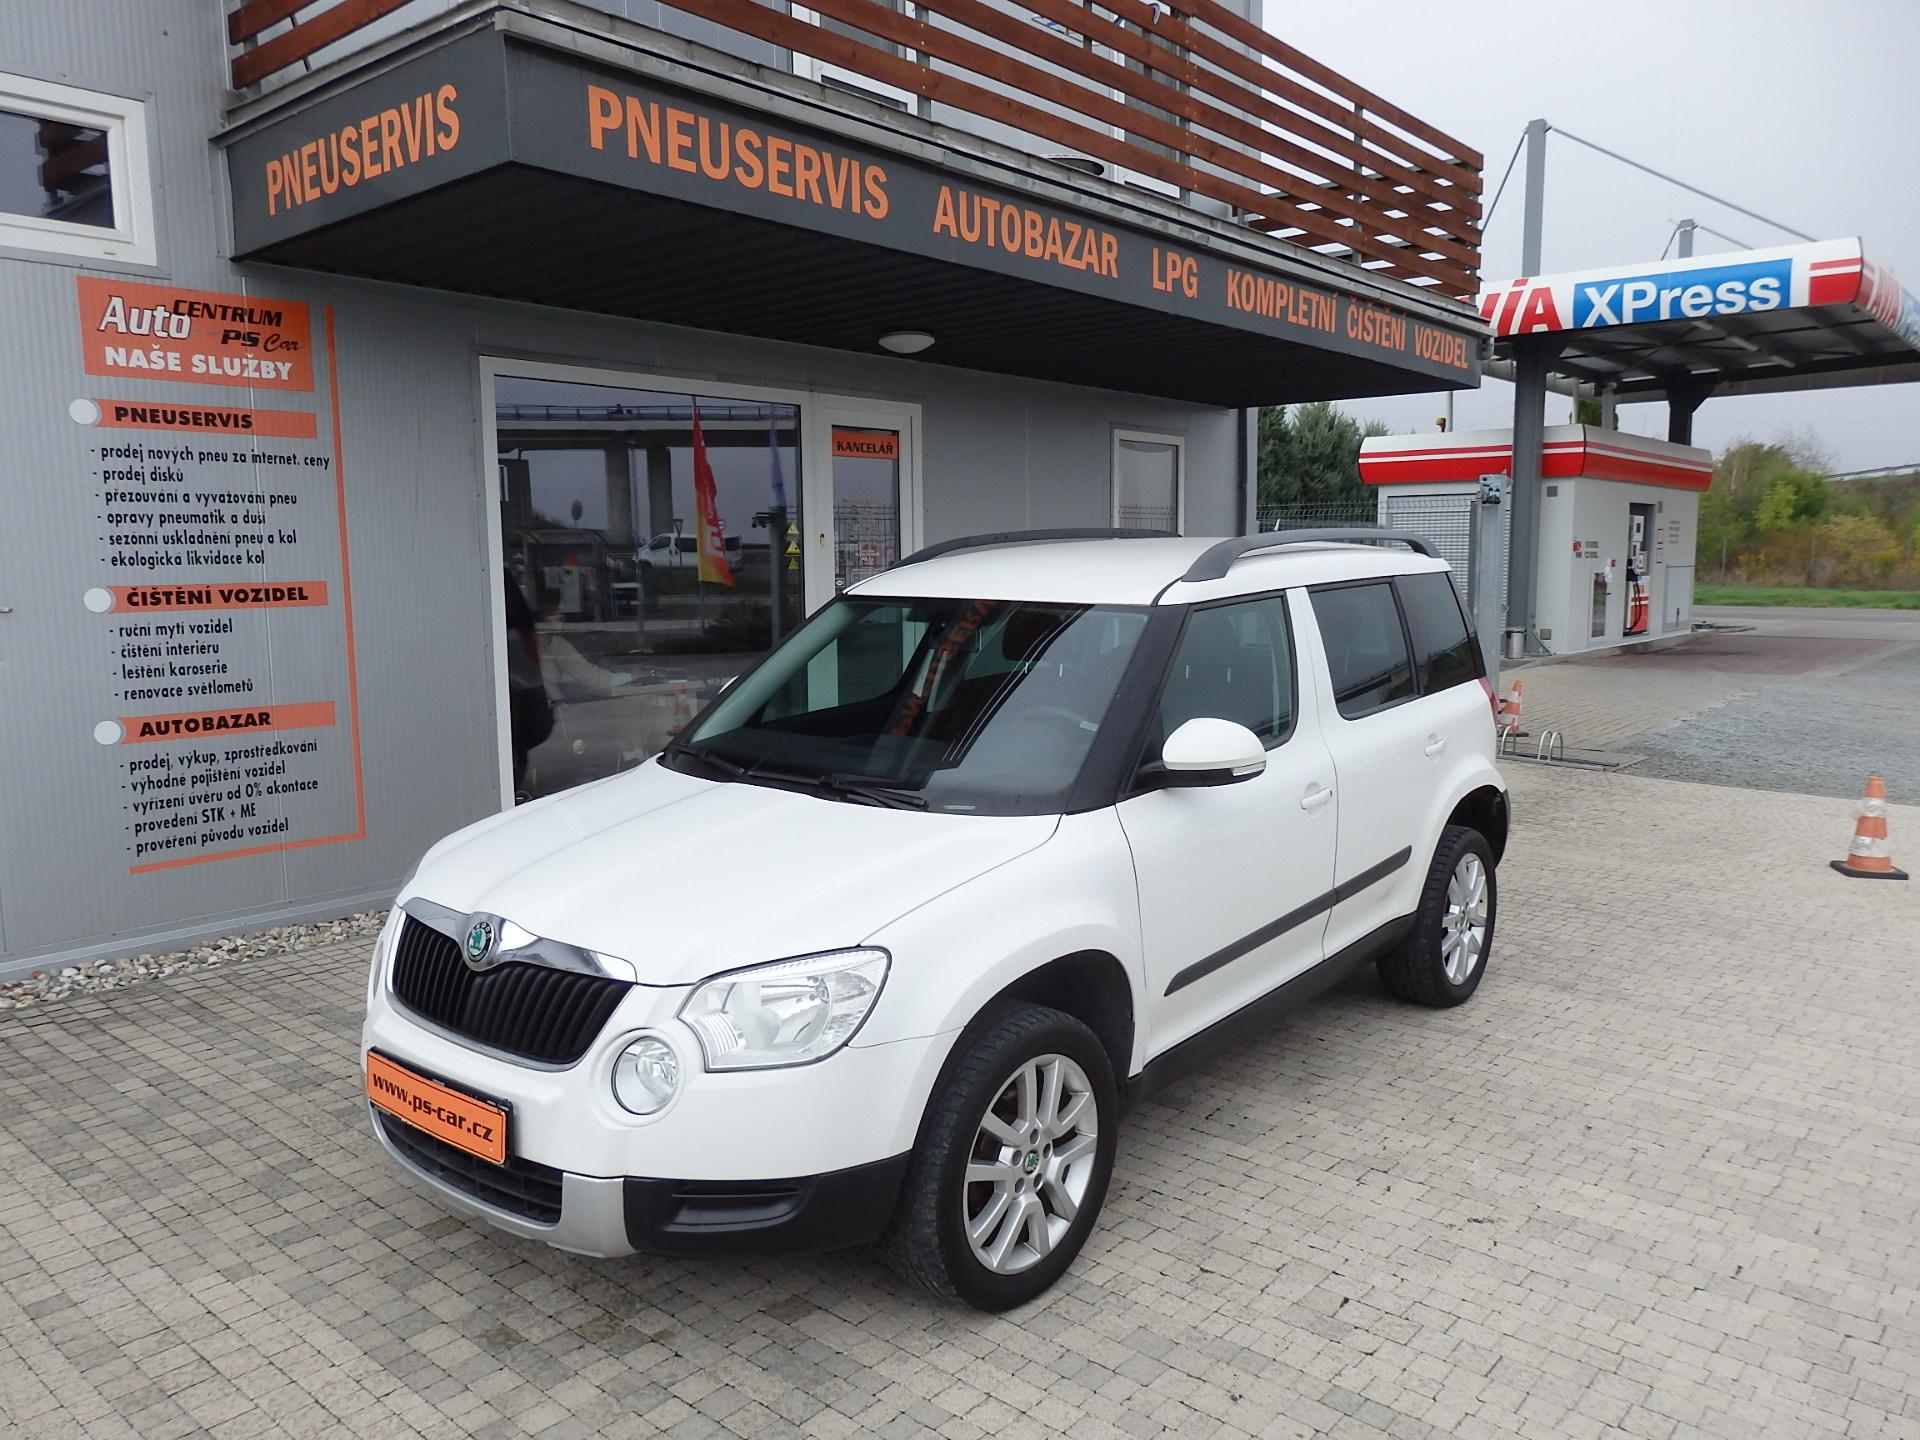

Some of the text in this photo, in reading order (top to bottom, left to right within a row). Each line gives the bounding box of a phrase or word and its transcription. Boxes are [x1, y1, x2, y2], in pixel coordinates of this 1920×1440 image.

[266, 84, 460, 215] PNEUSERVIS
[587, 85, 889, 219] PNEUSERVIS
[933, 185, 1119, 278] AUTOBAZAR
[1152, 248, 1198, 299] LPG
[1227, 269, 1339, 333] KOMPLETNÍ
[1415, 324, 1469, 369] VOZIDEL
[1582, 277, 1781, 328] XPress
[97, 295, 282, 339] Auto CENTRUM
[221, 329, 300, 353] PS Car
[104, 344, 292, 380] NAŠE SLUŽBY
[114, 406, 253, 429] PNEUSERVIS
[101, 443, 330, 470] prodej nových pneu za internet. ceny
[837, 441, 894, 455] KANCELÁŘ
[103, 465, 145, 485] prodej
[183, 493, 190, 503] a
[270, 494, 297, 507] pneu
[107, 513, 153, 528] opravy
[159, 509, 226, 527] pneumatik
[230, 514, 238, 524] a
[235, 534, 263, 548] pneu
[267, 534, 275, 544] a
[279, 529, 297, 544] kol
[111, 550, 265, 570] ekologická likvidace kol
[127, 585, 309, 607] ČIŠTĚNÍ VOZIDEL
[189, 618, 233, 634] vozidel
[166, 640, 219, 656] interiéru
[169, 659, 228, 677] karoserie
[124, 686, 183, 701] renovace
[139, 712, 272, 737] AUTOBAZAR
[130, 738, 317, 775] prodej, výkup, zprostředkování
[245, 760, 286, 777] vozidel
[227, 786, 241, 801] od
[246, 782, 263, 798] 0%
[267, 778, 319, 795] akontace
[201, 807, 225, 824] STK
[240, 802, 256, 818] ME
[201, 825, 244, 847] původu
[248, 817, 289, 836] vozidel
[372, 1071, 494, 1142] www.ps-car.cz
